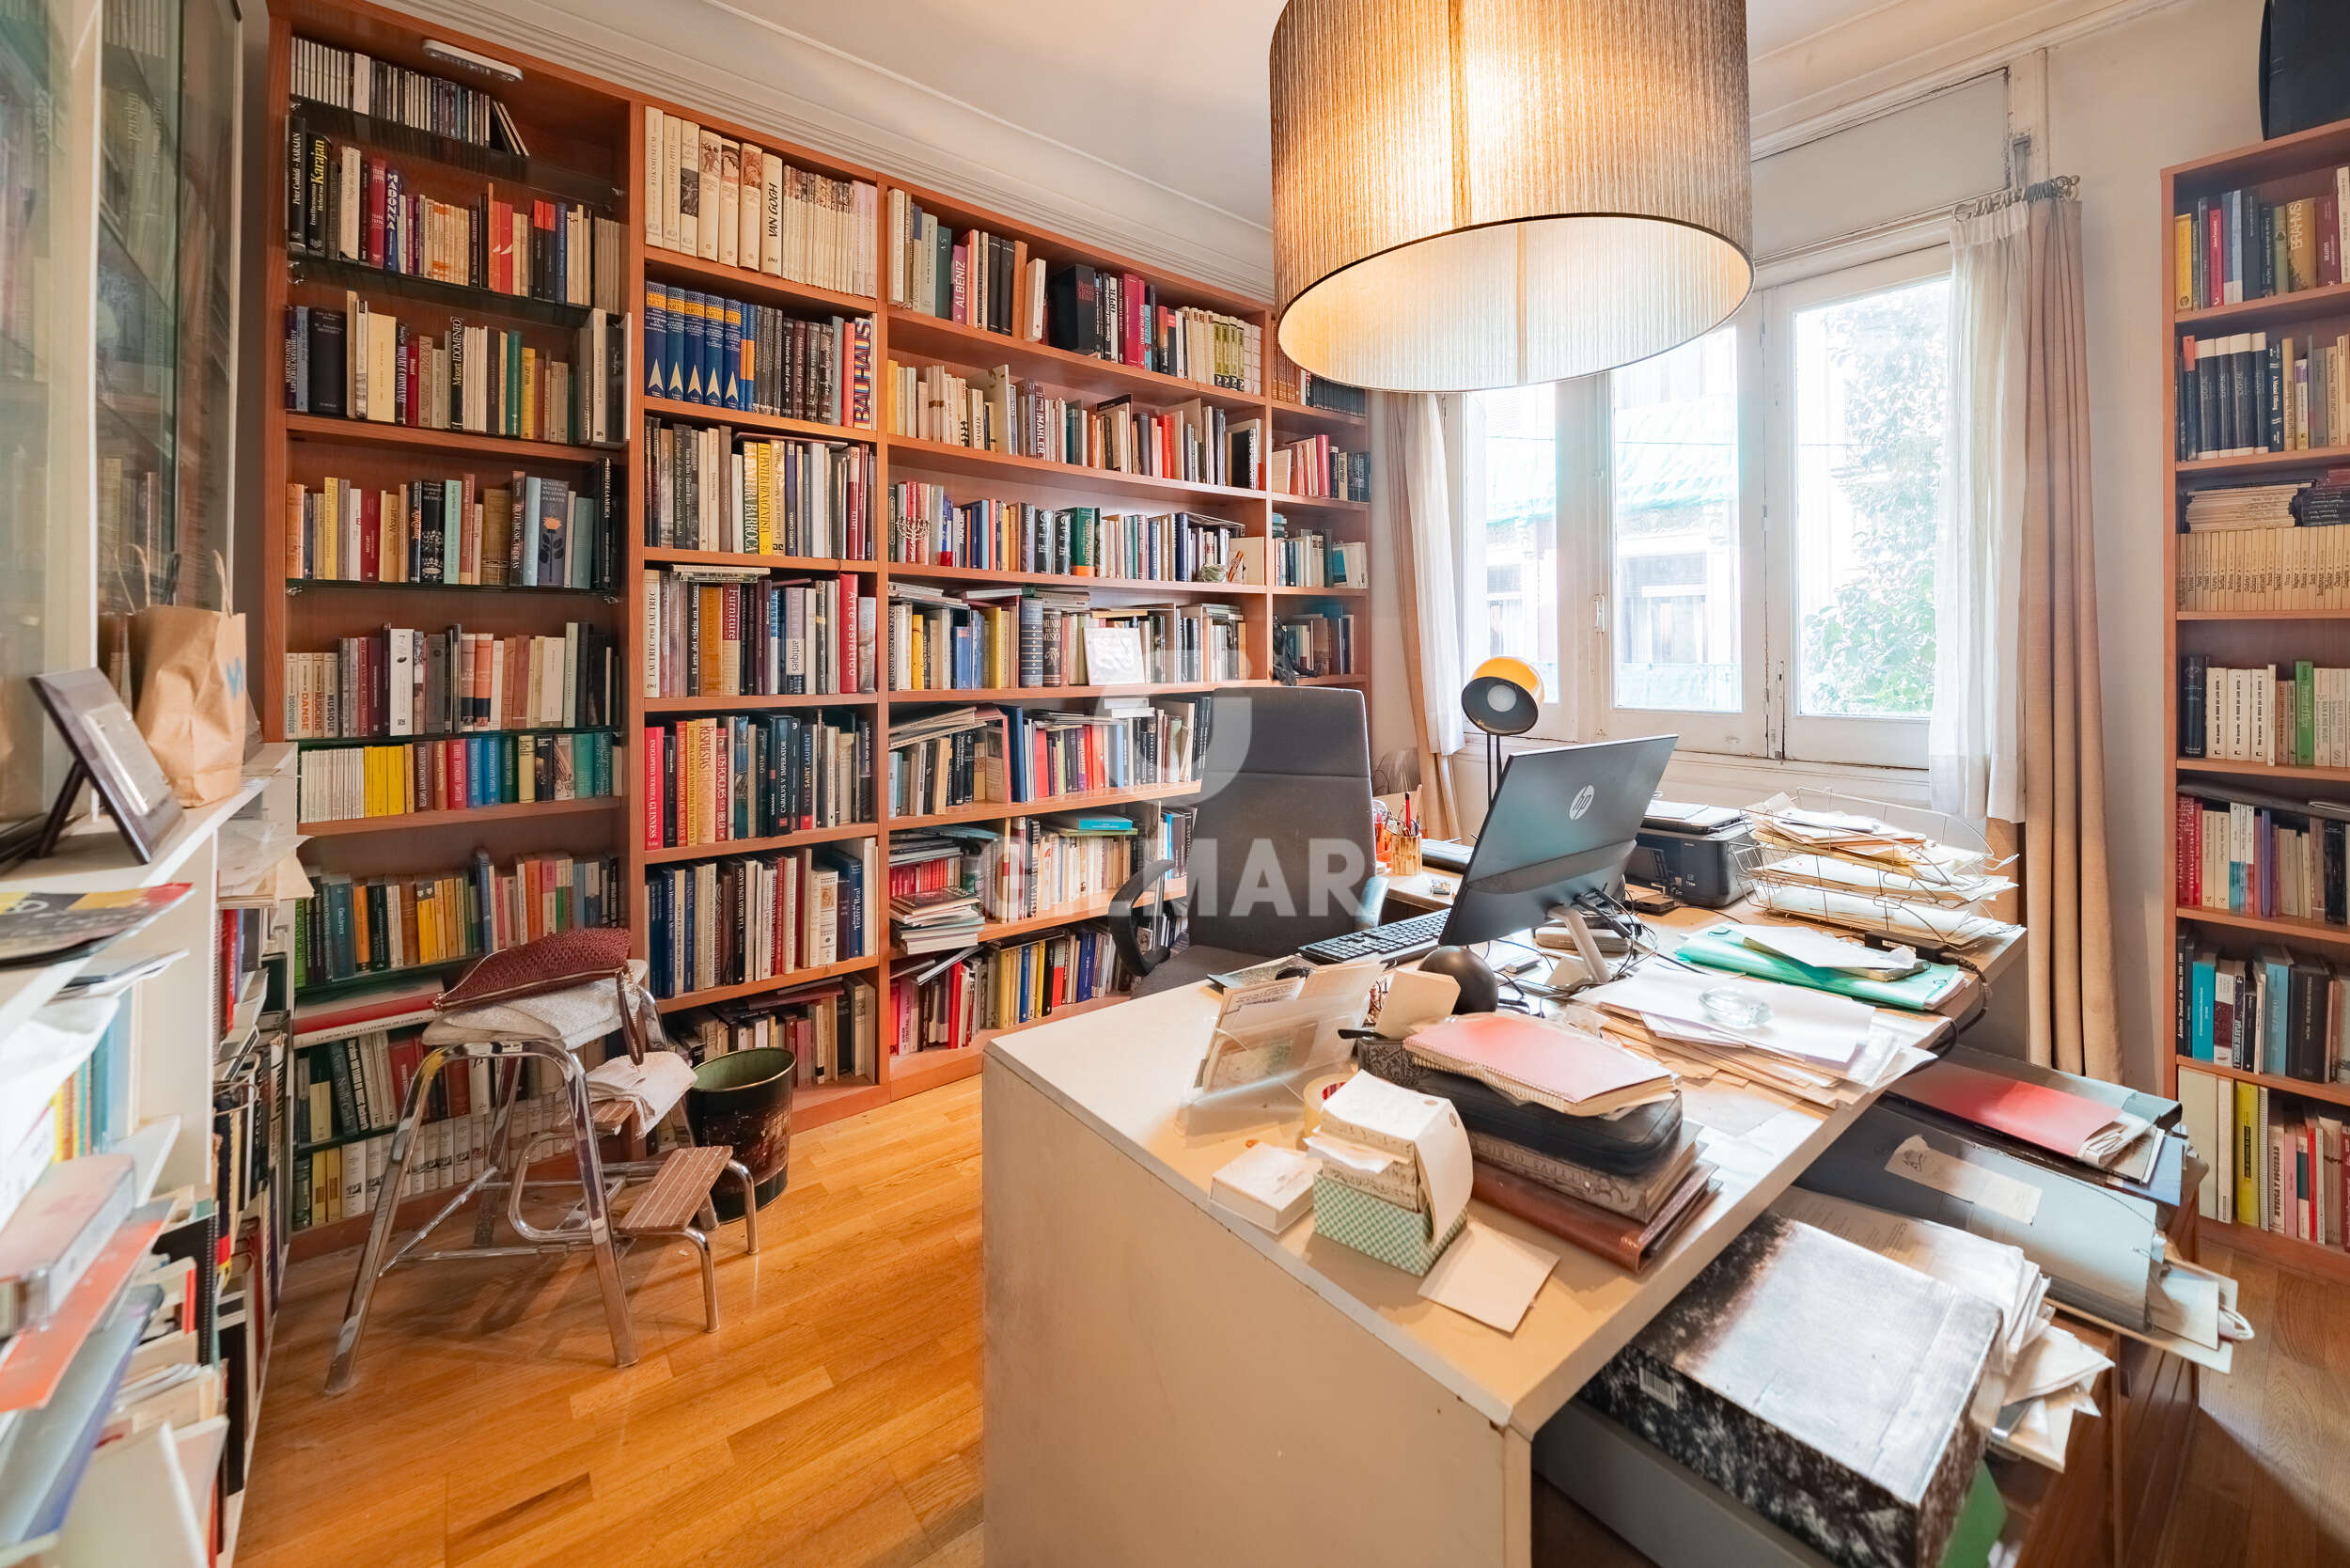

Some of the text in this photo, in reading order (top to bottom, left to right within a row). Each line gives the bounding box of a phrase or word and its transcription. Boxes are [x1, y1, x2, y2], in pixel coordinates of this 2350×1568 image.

[292, 133, 301, 163] KARAJAN
[310, 139, 327, 184] Karajan
[386, 173, 399, 230] MADONNA
[768, 182, 778, 238] VAN GOGH
[2289, 202, 2303, 250] BRAHMS
[954, 259, 966, 308] ALBÉNIZ
[451, 319, 462, 386] Mozart IDOMENEO
[854, 320, 871, 424] BAUHAUS
[744, 456, 758, 501] PINTURA
[760, 457, 770, 484] PINTURA
[389, 509, 398, 532] Mozart
[744, 504, 759, 552] BARROCA
[760, 485, 771, 533] RENACENTISTA
[648, 589, 656, 626] LAUTREC
[728, 588, 739, 640] Furniture
[848, 591, 857, 619] Arte
[648, 641, 656, 677] LAUTREC
[791, 640, 801, 671] antiques
[699, 726, 715, 770] RESPUESTAS
[649, 801, 657, 839] GUINNESS
[717, 811, 727, 828] BIBLIA
[1570, 785, 1594, 820] hp
